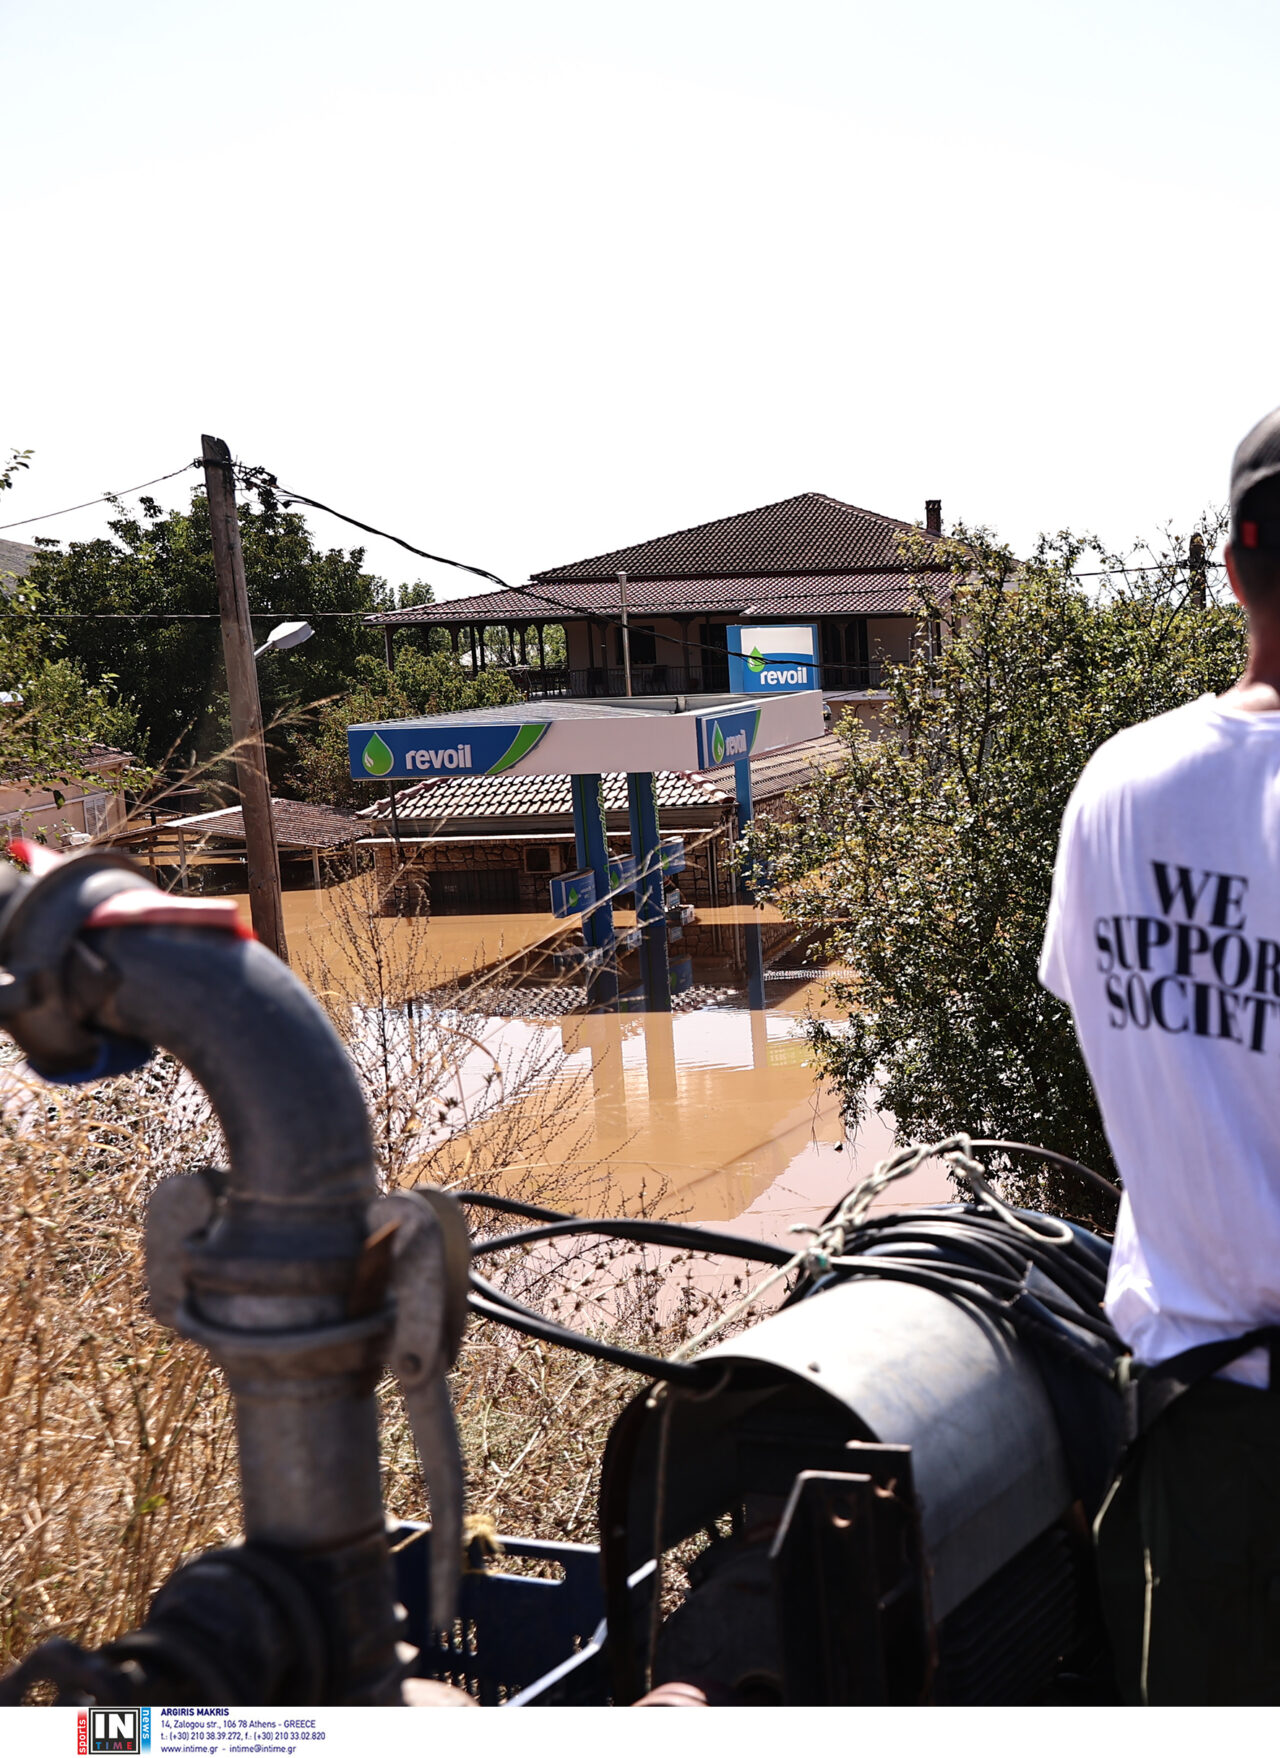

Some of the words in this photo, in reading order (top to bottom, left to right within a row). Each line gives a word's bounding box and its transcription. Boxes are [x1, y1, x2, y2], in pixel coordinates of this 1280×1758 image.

[760, 666, 807, 685] revoil
[405, 744, 472, 770] revoil
[1150, 859, 1249, 931] WE
